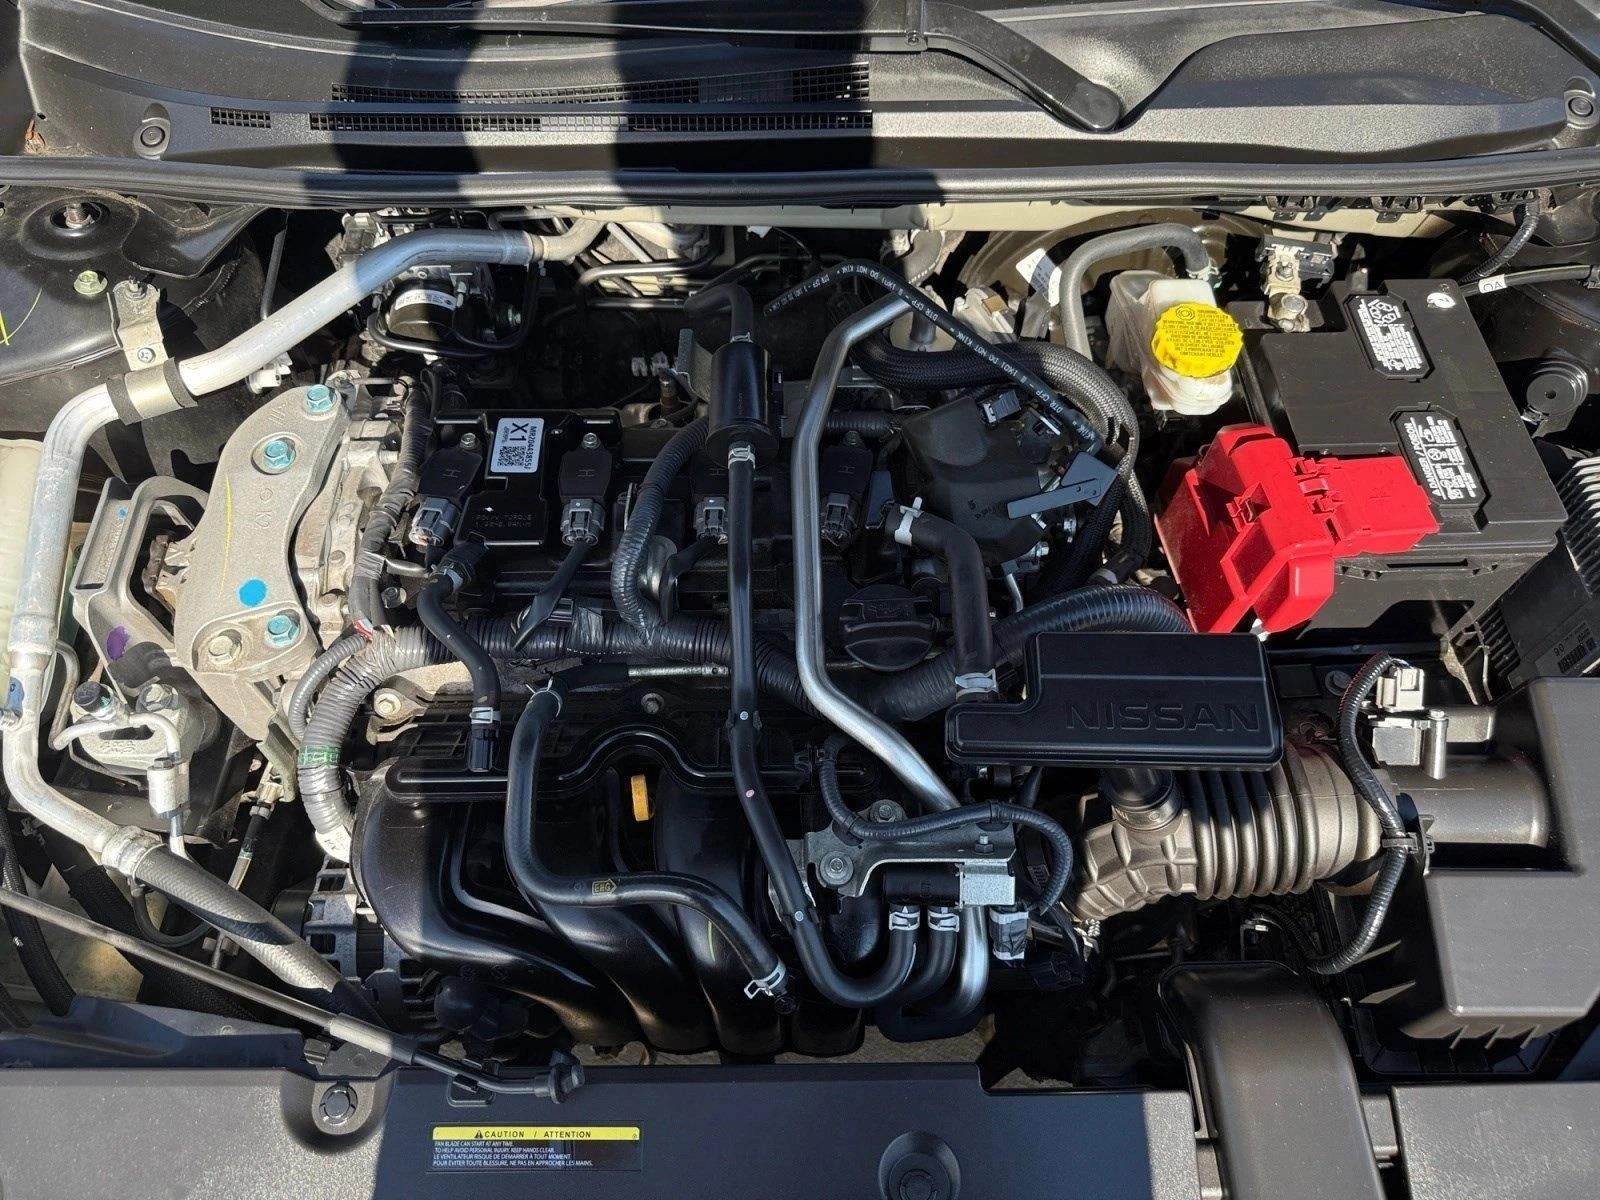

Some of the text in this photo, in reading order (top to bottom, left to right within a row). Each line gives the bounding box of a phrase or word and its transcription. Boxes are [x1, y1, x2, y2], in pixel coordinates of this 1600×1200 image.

[855, 265, 866, 273] NOT
[910, 297, 924, 310] CFP
[924, 307, 939, 320] DTR
[955, 330, 973, 346] KINK
[973, 343, 988, 357] NOT
[1034, 387, 1050, 402] CFP
[1048, 399, 1063, 414] DTR
[509, 422, 529, 441] X1
[1403, 422, 1422, 450] POISON
[1417, 457, 1438, 489] DANGER
[1066, 702, 1260, 732] NISSAN
